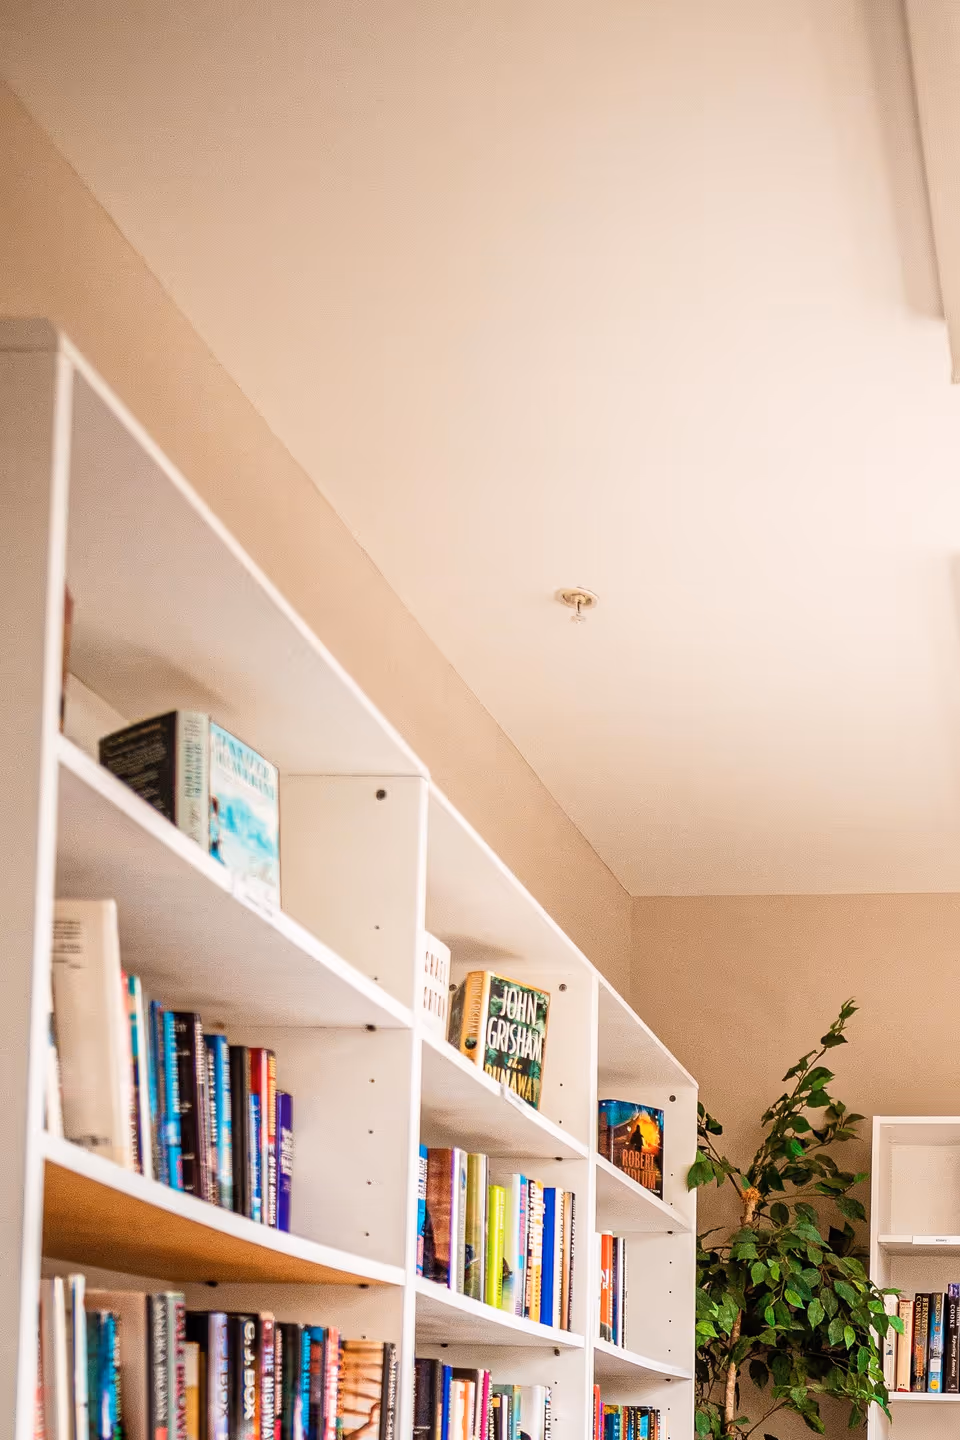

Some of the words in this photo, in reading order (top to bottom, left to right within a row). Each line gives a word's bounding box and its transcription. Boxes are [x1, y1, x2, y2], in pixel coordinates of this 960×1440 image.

[501, 986, 538, 1026] JOHN
[488, 1016, 543, 1062] GRISHAM
[507, 1057, 523, 1070] the
[622, 1148, 655, 1171] ROBERT
[175, 1303, 186, 1356] DALE
[244, 1321, 256, 1365] C.J.
[264, 1347, 274, 1372] THE
[243, 1368, 256, 1421] BOX
